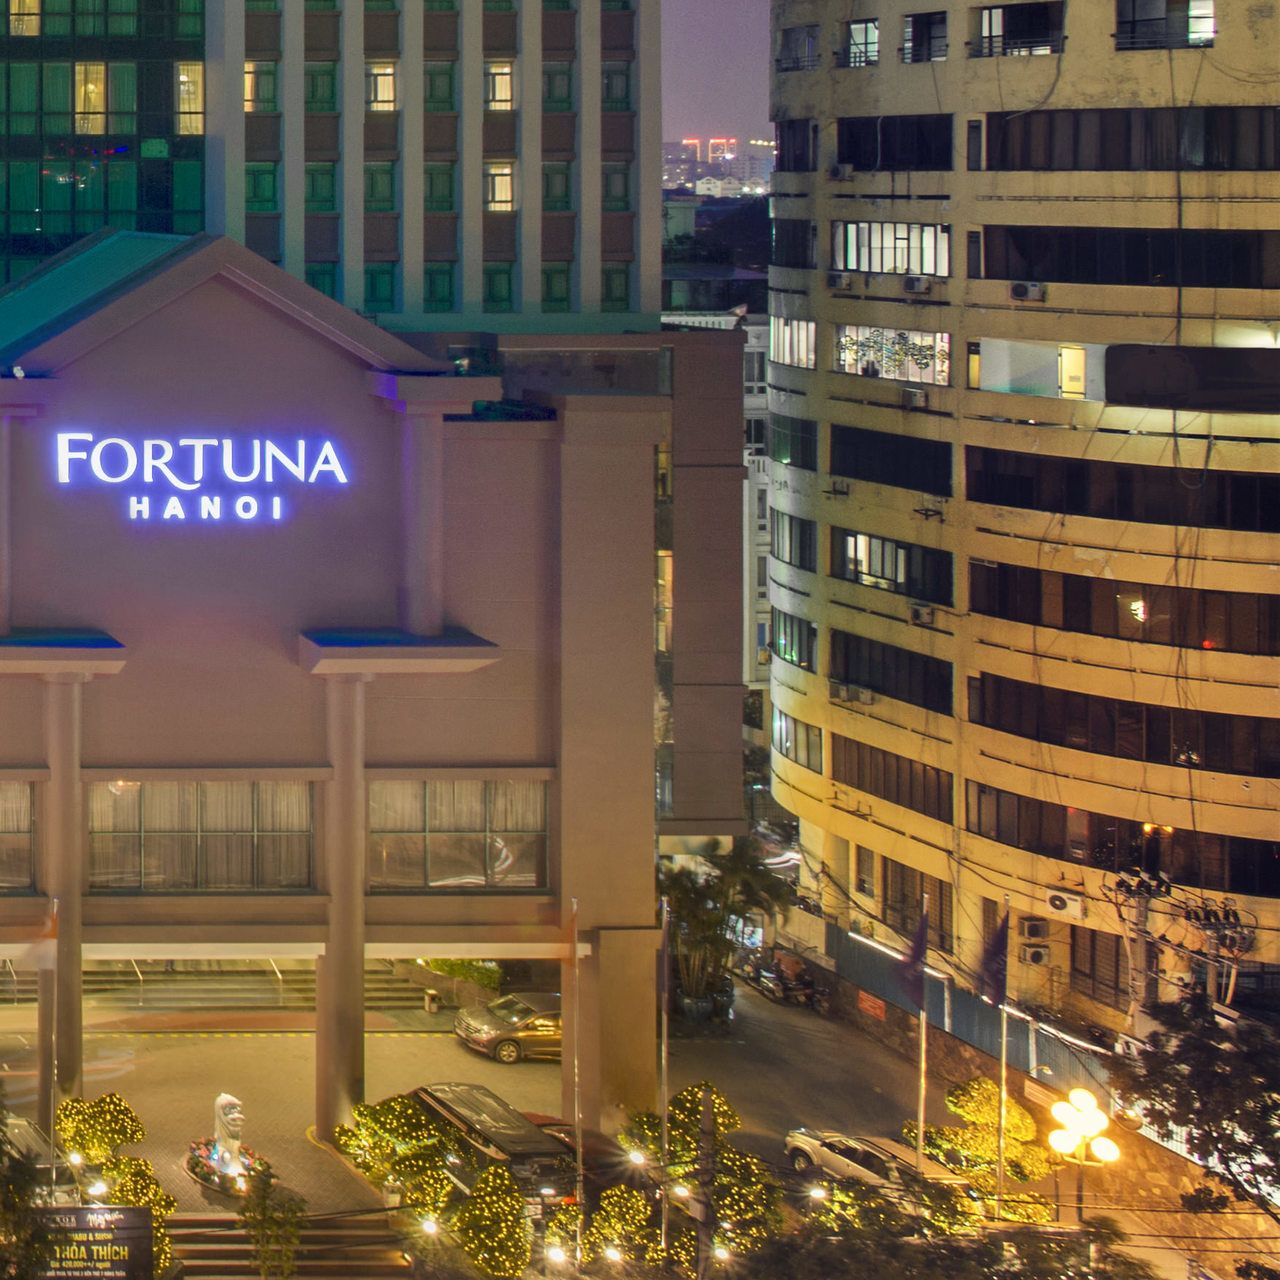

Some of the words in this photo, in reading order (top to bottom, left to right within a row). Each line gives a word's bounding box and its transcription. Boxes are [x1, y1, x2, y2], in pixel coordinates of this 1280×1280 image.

[56, 431, 350, 492] FORTUNA
[128, 495, 282, 520] HANOI
[90, 1242, 129, 1261] THÍCH
